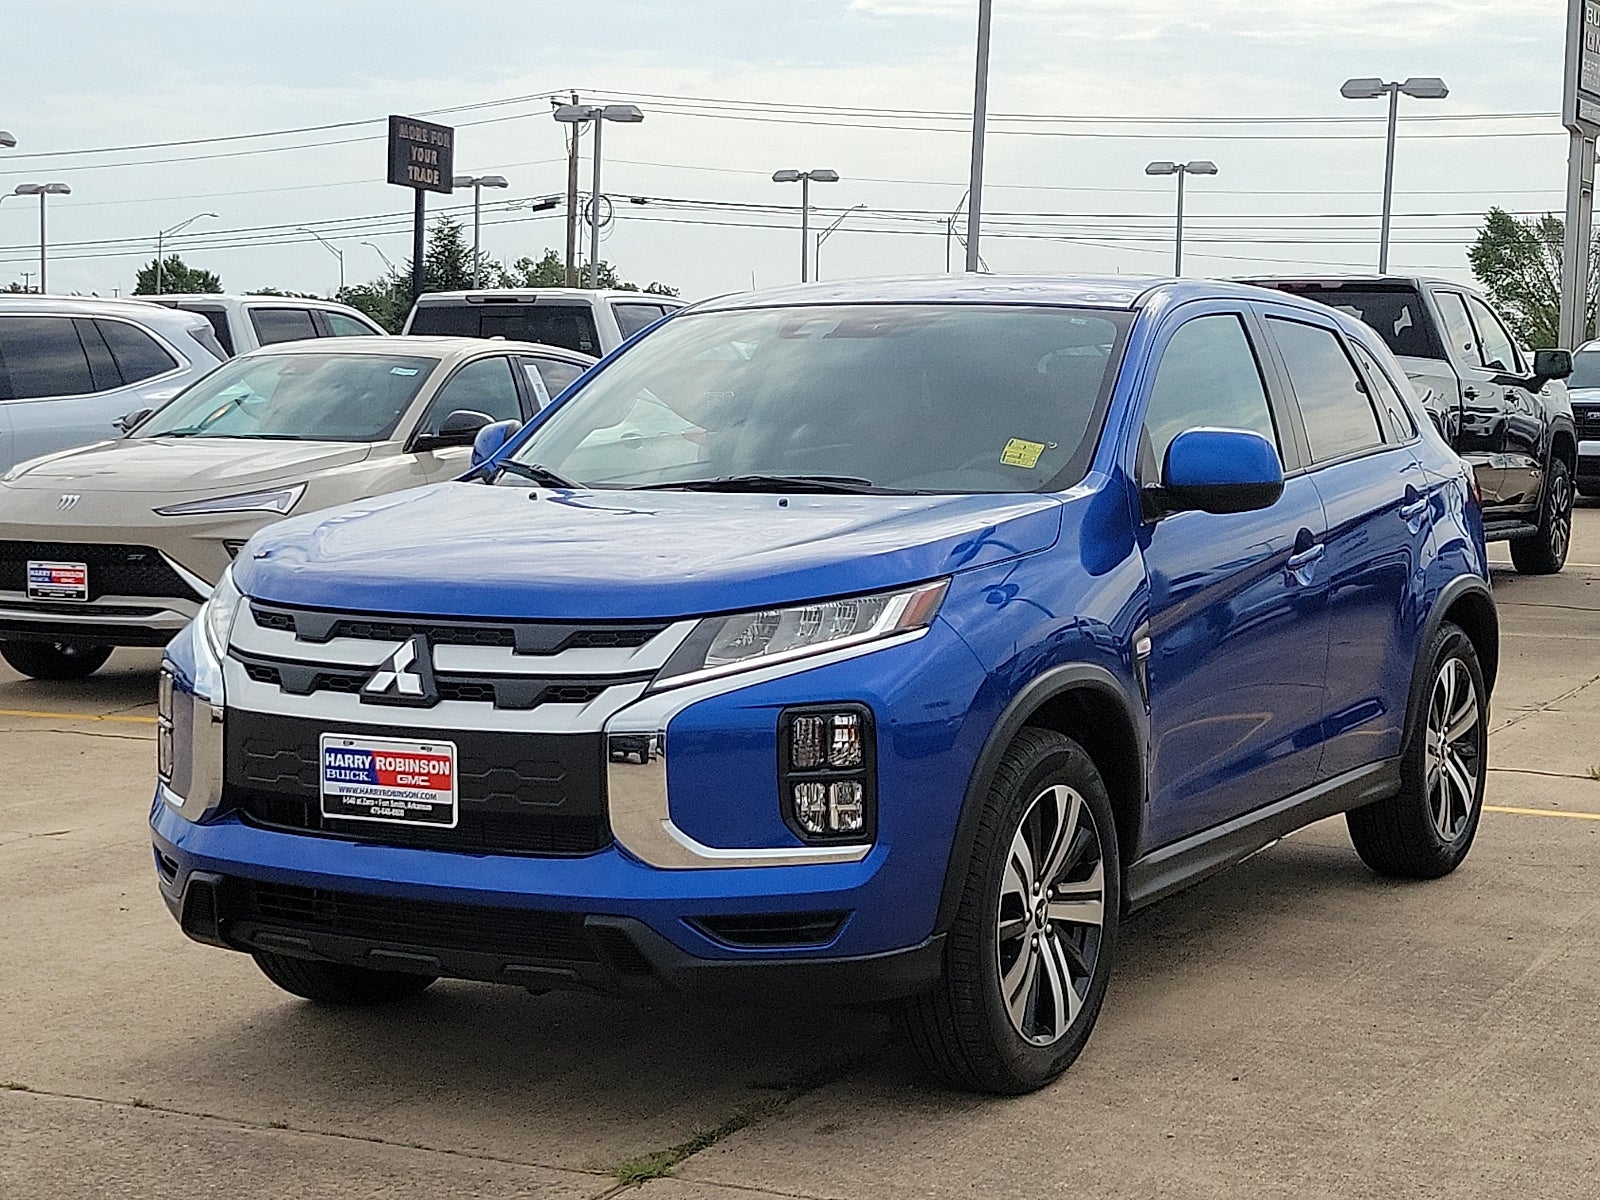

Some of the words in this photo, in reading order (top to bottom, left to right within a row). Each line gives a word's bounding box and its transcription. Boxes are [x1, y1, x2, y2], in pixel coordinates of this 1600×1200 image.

[430, 130, 451, 148] FOR
[411, 145, 438, 165] YOUR
[408, 166, 439, 185] TRADE
[325, 752, 373, 769] HARRY
[375, 756, 450, 775] ROBINSON
[396, 774, 431, 786] GMC
[338, 785, 437, 800] WWW.HARRYROBINSON.COM
